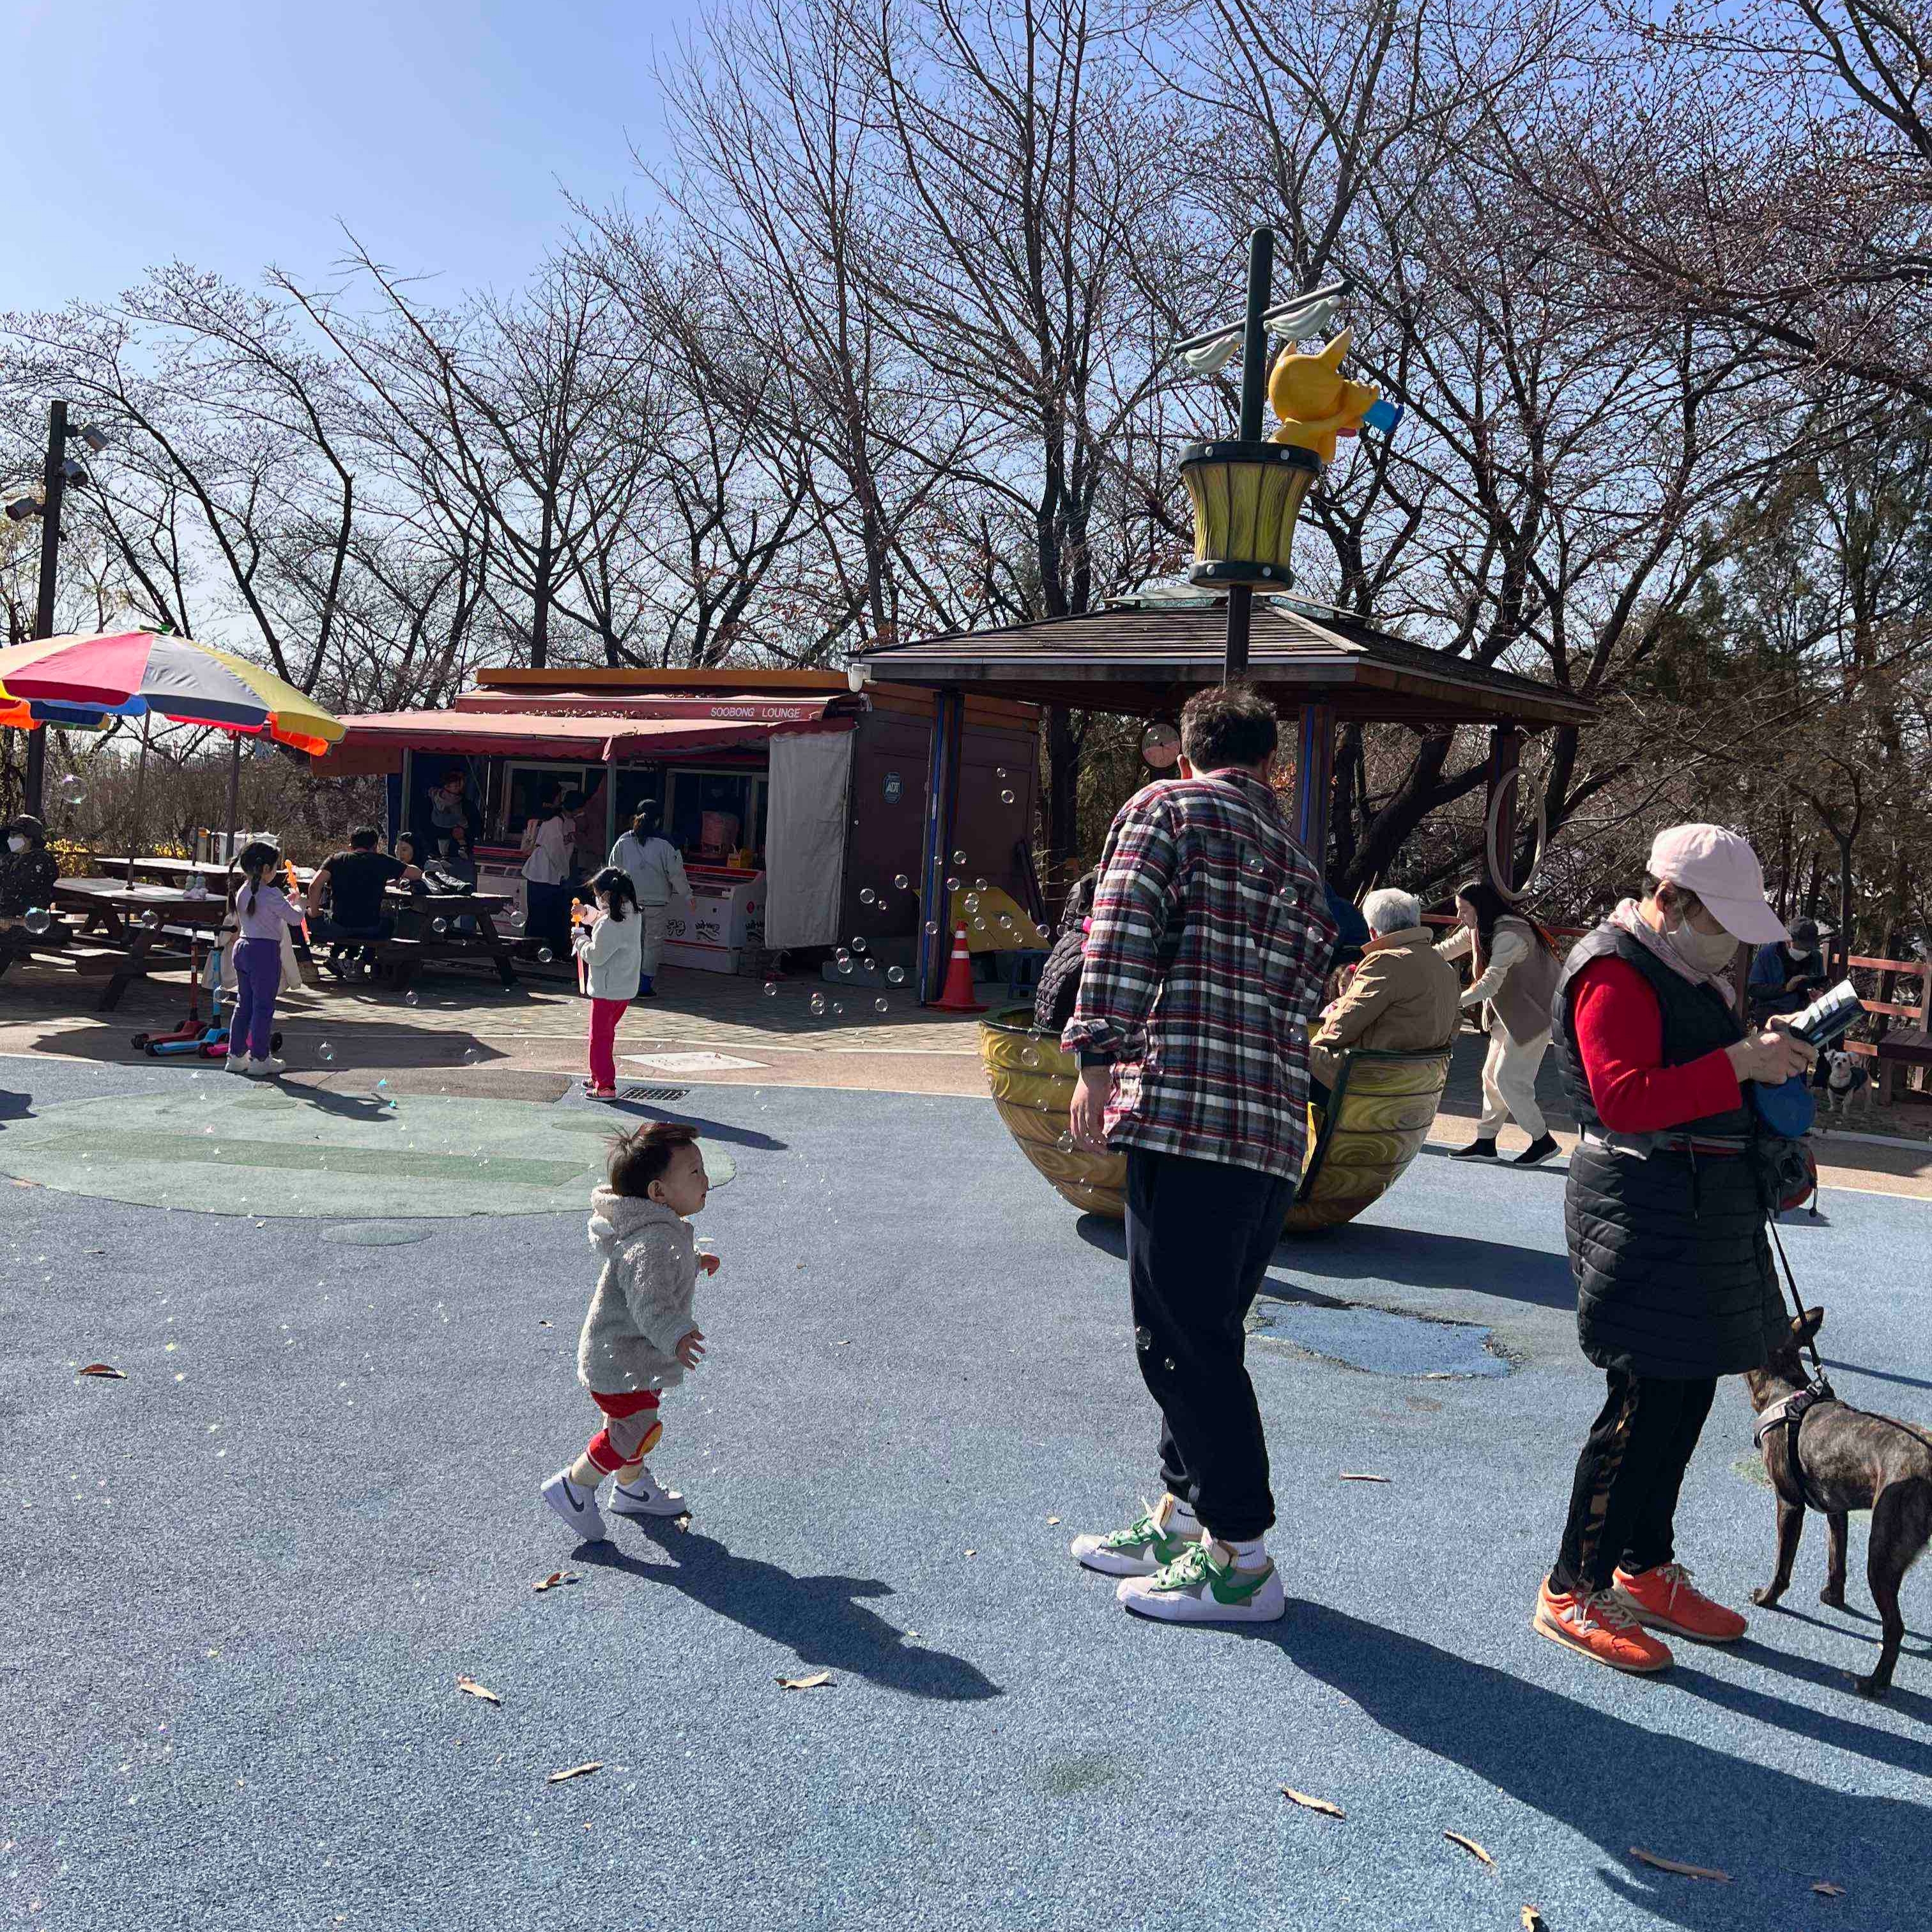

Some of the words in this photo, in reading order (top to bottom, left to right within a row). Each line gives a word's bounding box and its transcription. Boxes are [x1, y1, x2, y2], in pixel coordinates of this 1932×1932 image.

[710, 707, 755, 717] SOOBONG
[762, 707, 801, 718] LOUNGE
[885, 781, 900, 793] ADT
